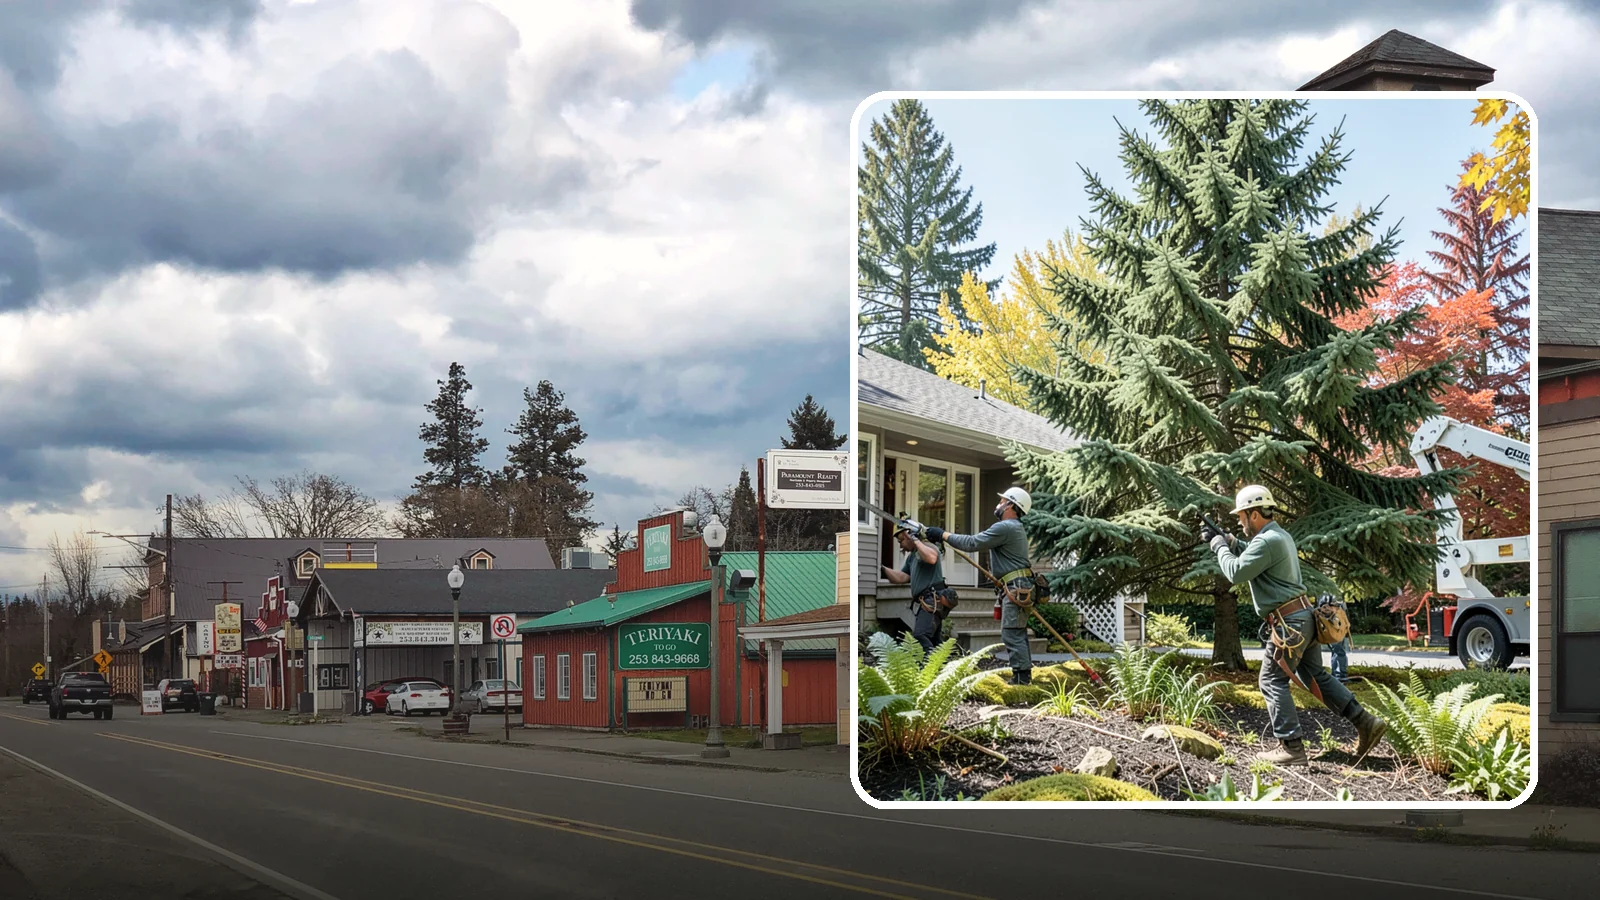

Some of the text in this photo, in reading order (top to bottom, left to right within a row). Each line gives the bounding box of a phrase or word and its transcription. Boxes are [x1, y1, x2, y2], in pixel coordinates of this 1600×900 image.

[646, 531, 668, 548] TERIYAKI
[625, 628, 702, 646] TERIYAKI
[629, 654, 700, 665] 253 843-9668
